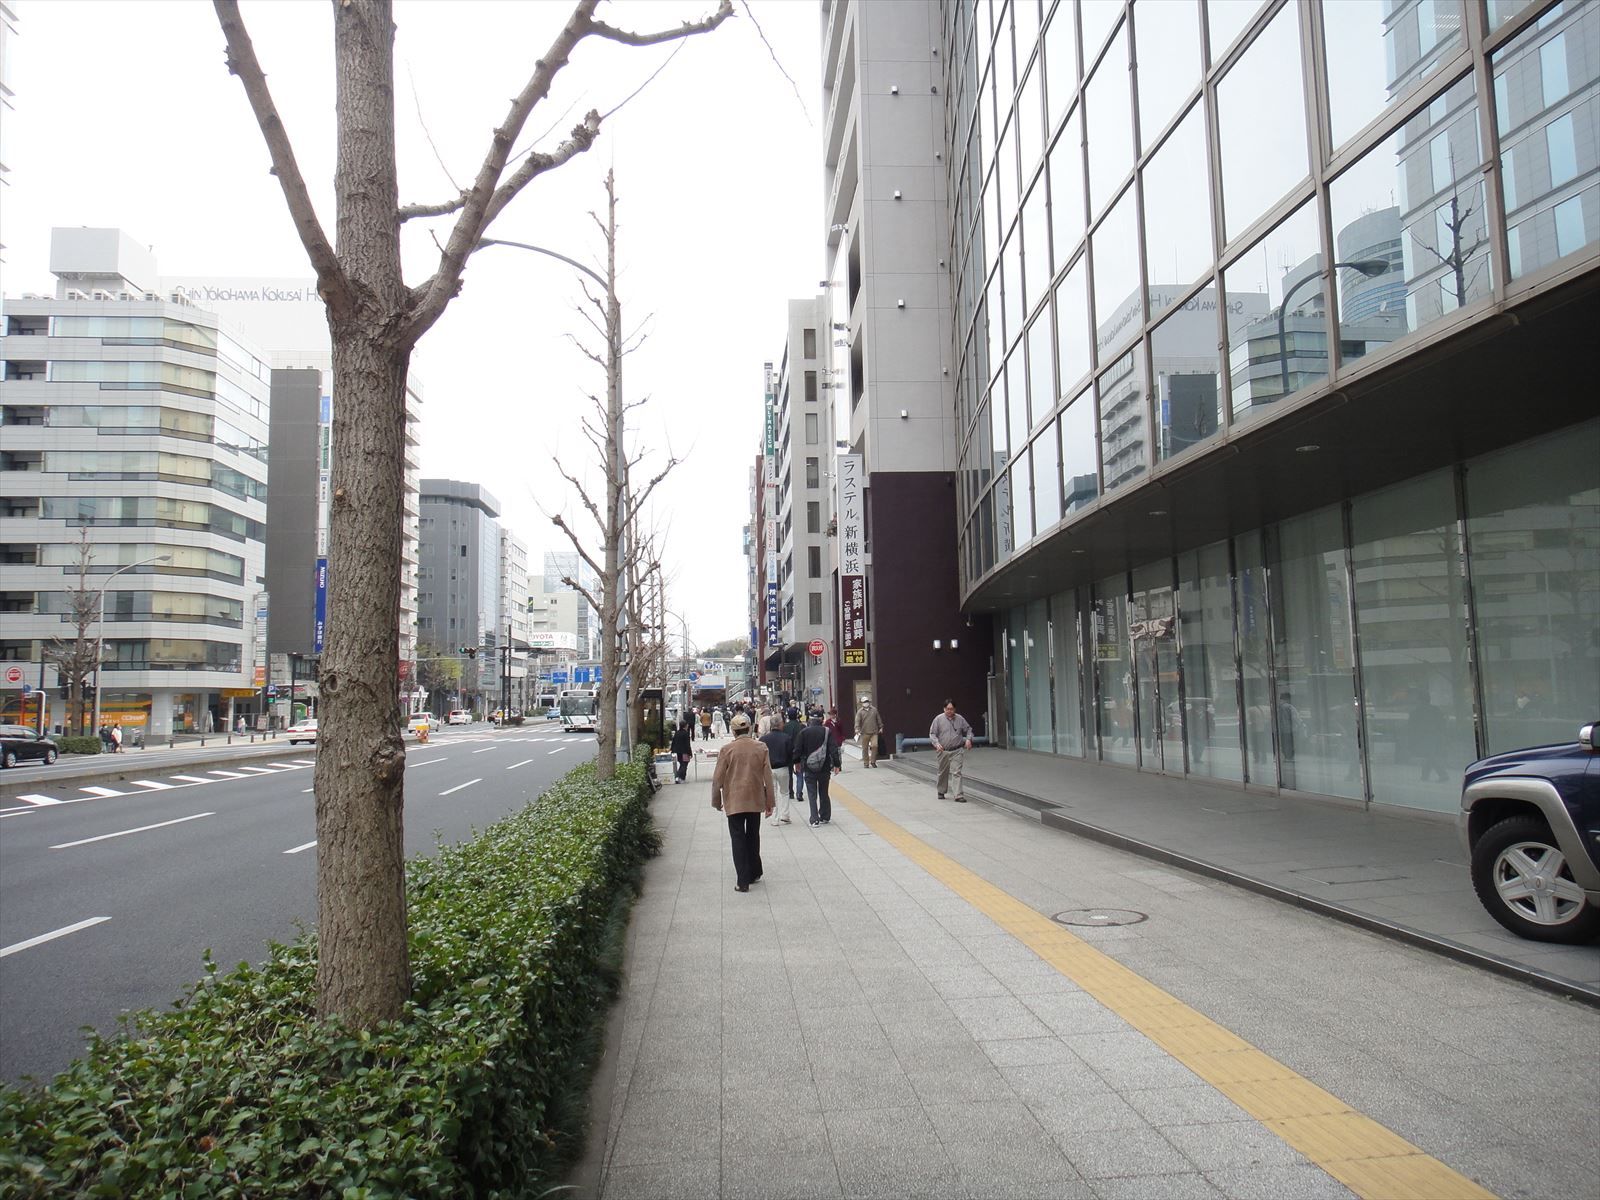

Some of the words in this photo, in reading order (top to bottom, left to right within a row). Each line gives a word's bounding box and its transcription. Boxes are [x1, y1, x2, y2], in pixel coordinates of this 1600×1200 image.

[203, 286, 259, 301] YOKOHAMA
[262, 286, 302, 302] KOKUSAI
[844, 460, 859, 574] ラステル新横浜
